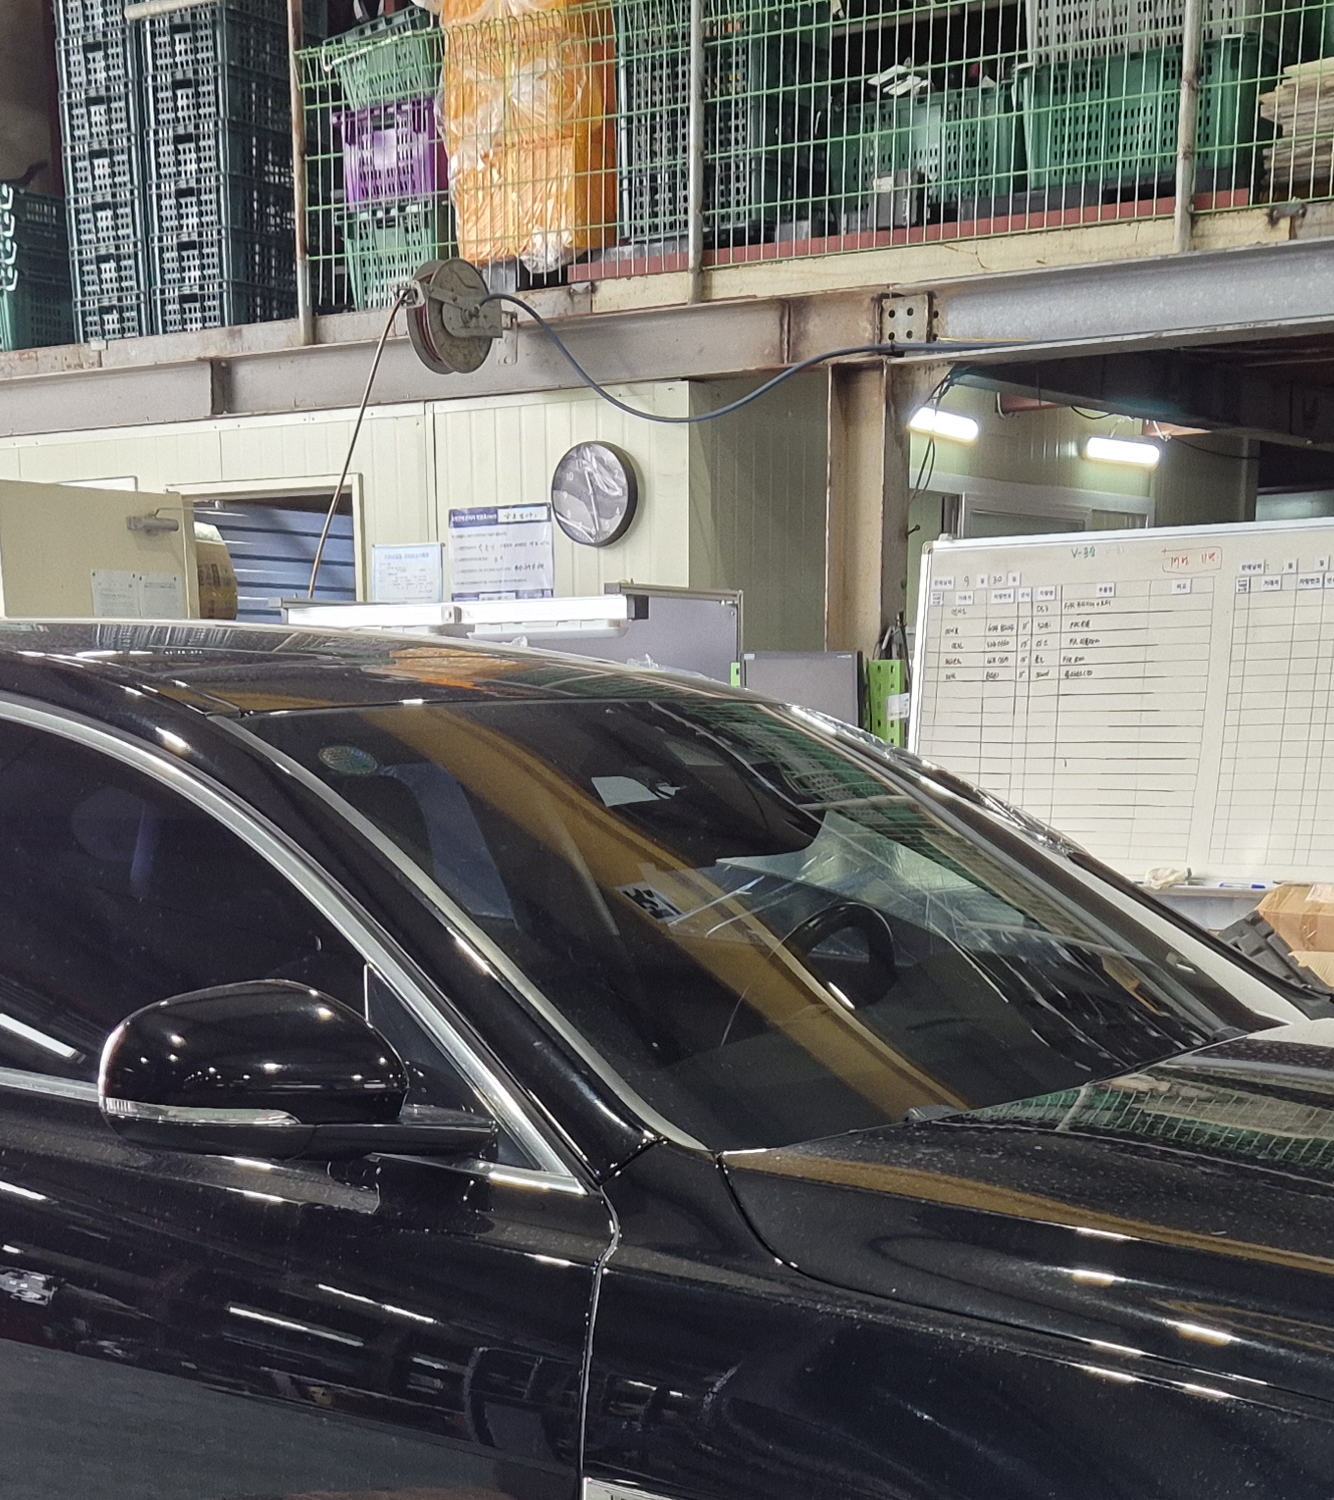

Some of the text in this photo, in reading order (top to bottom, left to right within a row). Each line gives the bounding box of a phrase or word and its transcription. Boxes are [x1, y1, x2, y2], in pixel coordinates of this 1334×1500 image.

[566, 471, 574, 481] 10
[963, 575, 970, 588] 9
[993, 575, 1003, 585] 30
